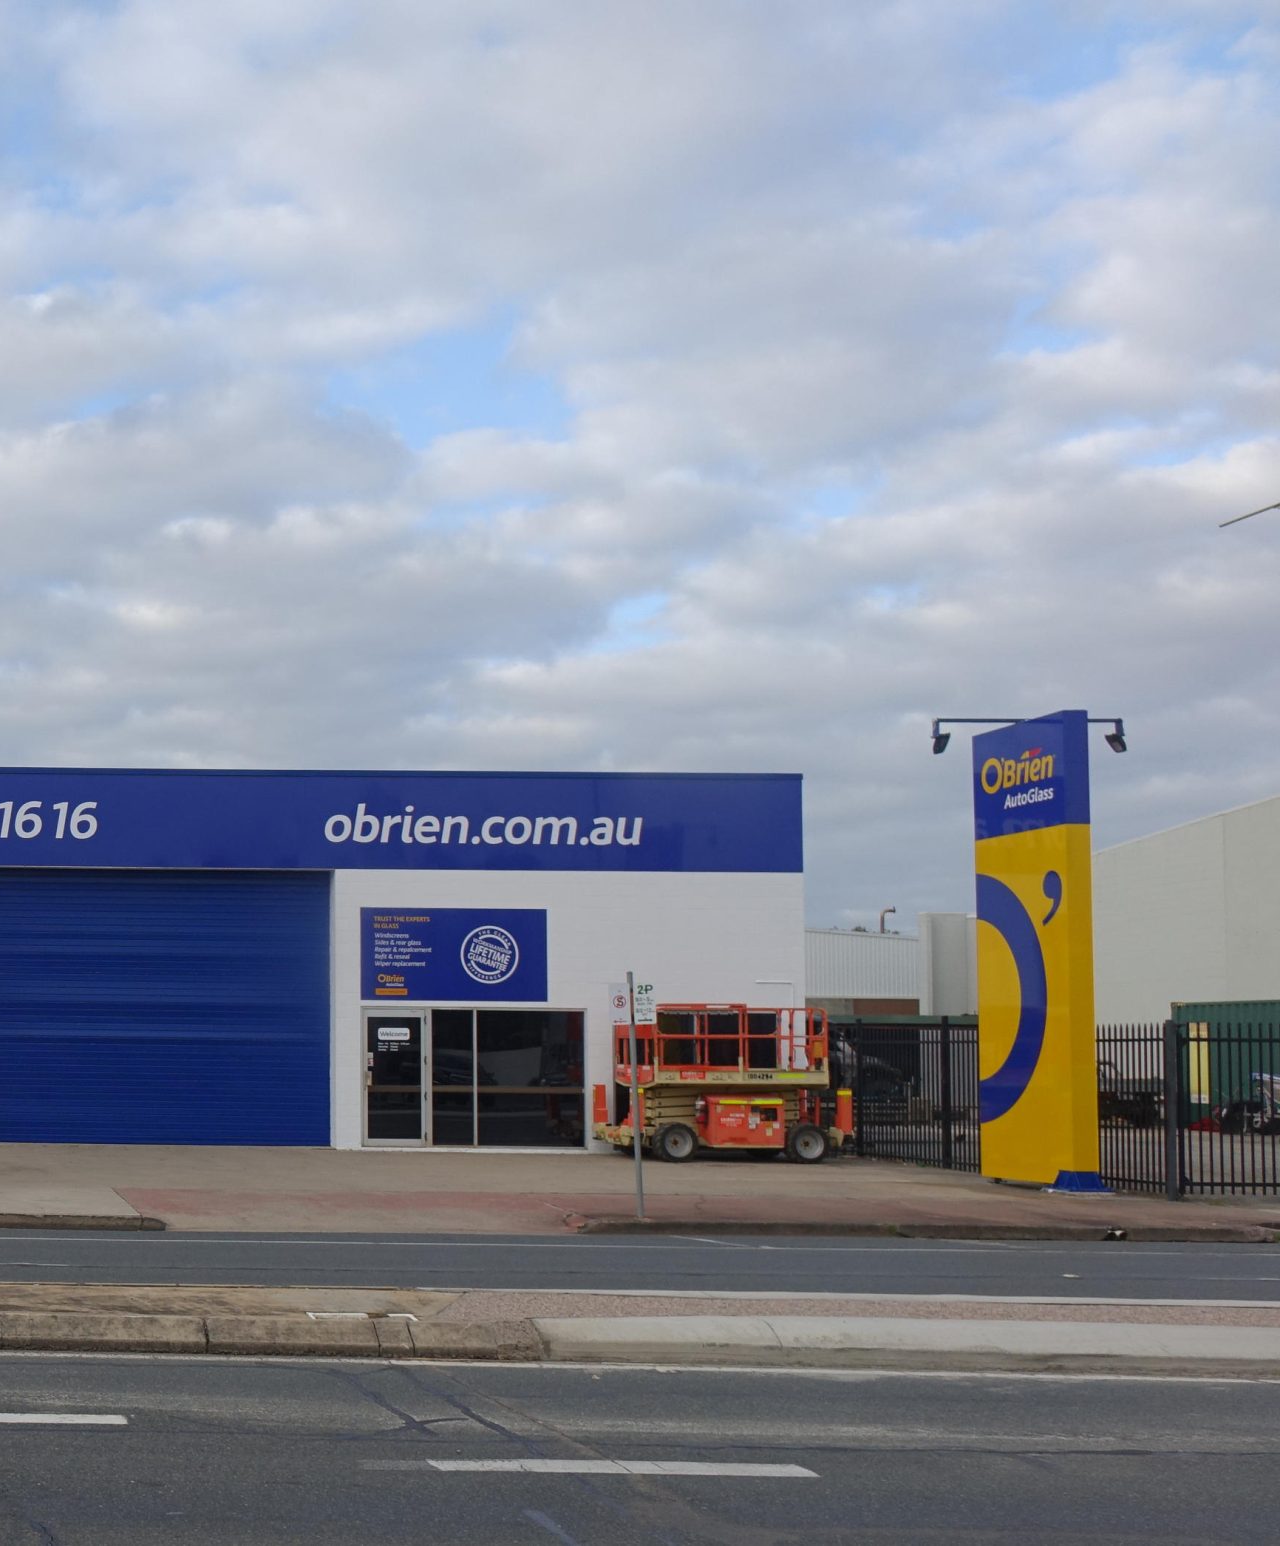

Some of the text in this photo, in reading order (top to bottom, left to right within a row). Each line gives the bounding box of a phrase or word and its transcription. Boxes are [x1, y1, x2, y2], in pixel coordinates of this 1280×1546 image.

[981, 748, 1055, 795] O'Brien
[1004, 787, 1054, 809] AutoGlass
[52, 801, 98, 840] 16
[324, 803, 643, 846] obrien.com.au
[467, 952, 508, 972] GUARANTEE
[470, 942, 511, 965] LIFETIME
[637, 984, 654, 995] 2P
